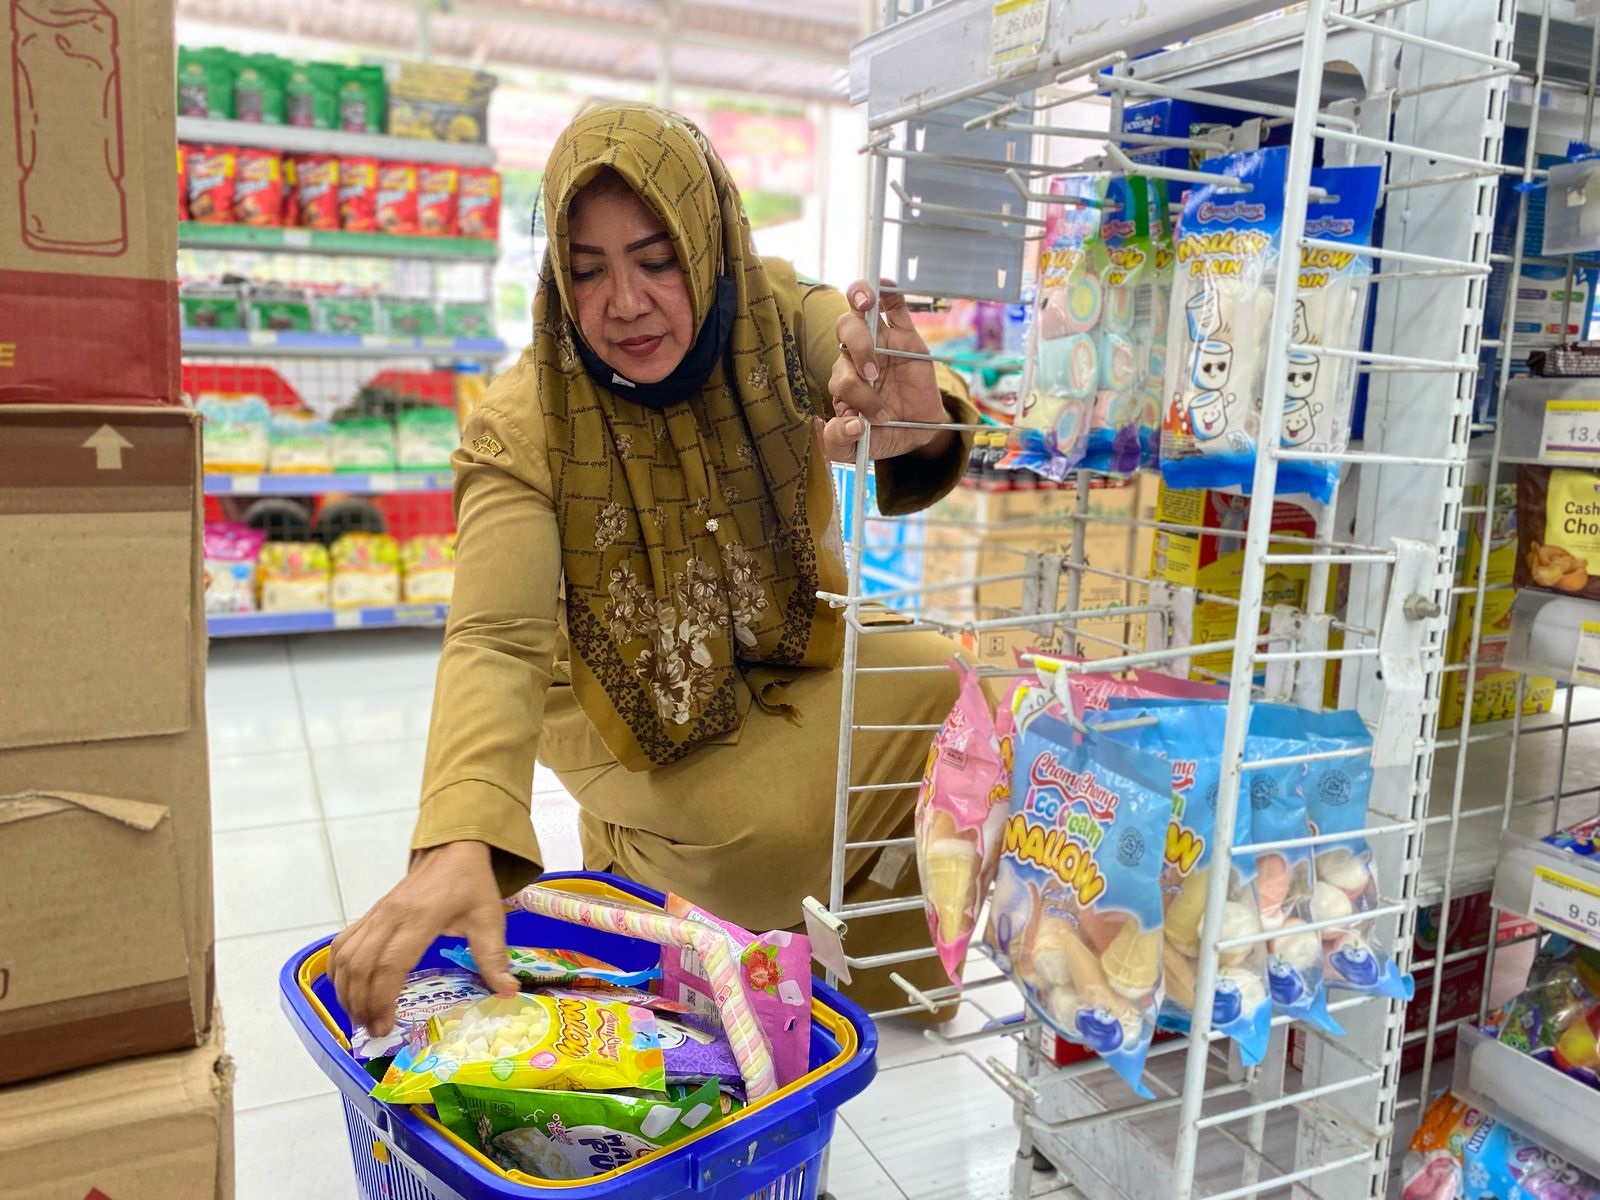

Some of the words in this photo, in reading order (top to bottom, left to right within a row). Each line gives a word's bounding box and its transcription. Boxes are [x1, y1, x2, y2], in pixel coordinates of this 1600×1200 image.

[1563, 518, 1600, 535] Cho
[1025, 786, 1058, 818] Ice
[1001, 813, 1106, 907] MALLOW
[1568, 903, 1600, 927] 9.5
